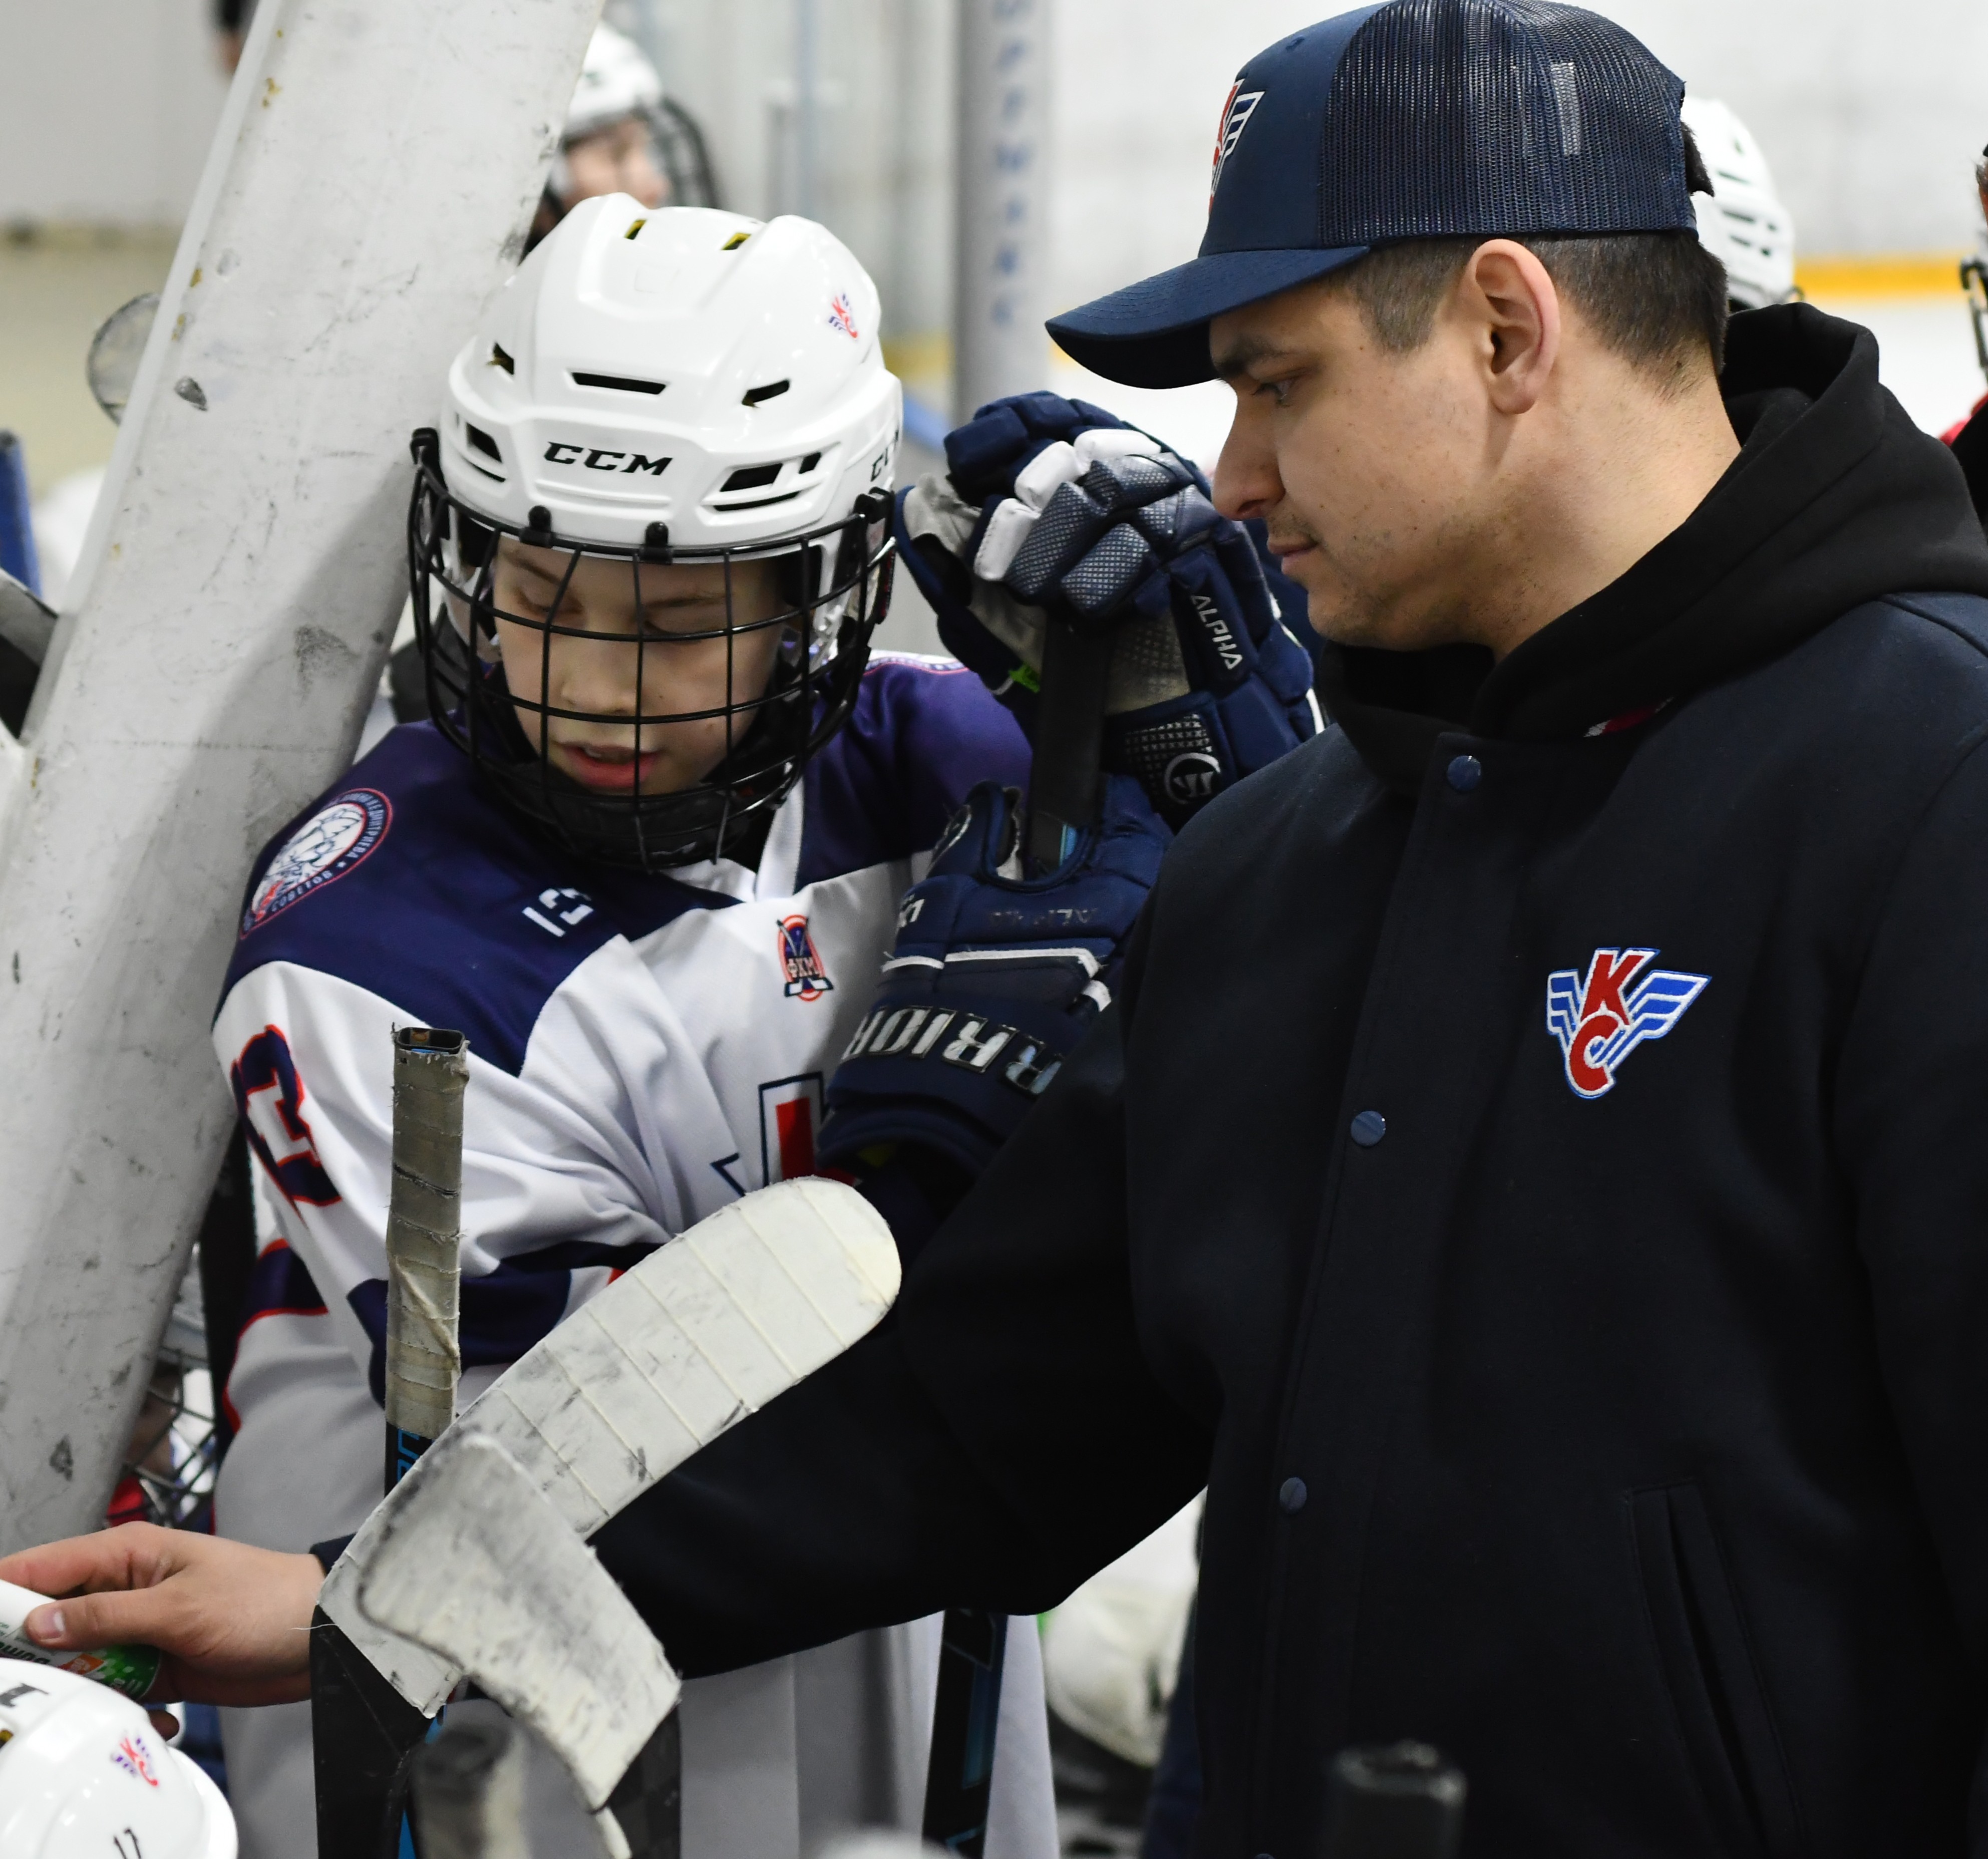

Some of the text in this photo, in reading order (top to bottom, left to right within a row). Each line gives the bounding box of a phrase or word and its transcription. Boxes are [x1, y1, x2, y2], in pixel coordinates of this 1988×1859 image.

[544, 441, 674, 476] CCM
[1191, 594, 1243, 670] ALPHA
[522, 887, 594, 938] 13
